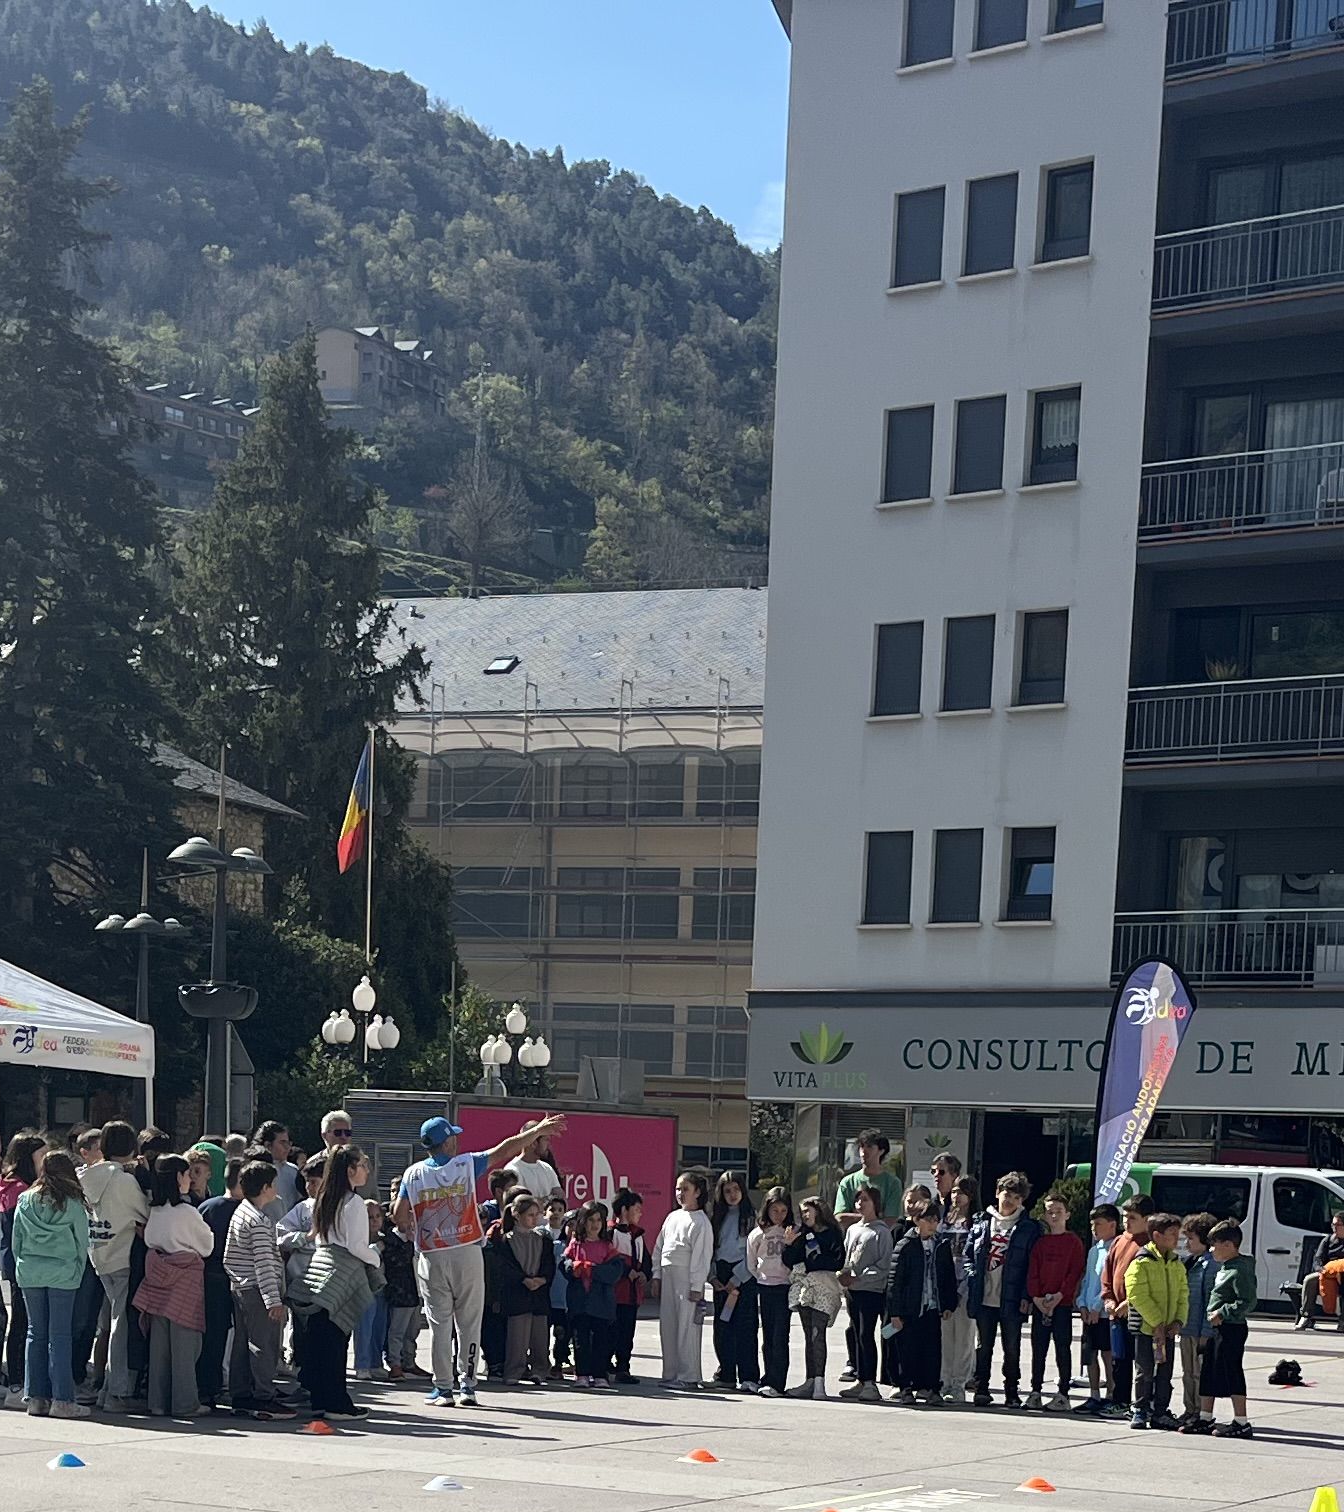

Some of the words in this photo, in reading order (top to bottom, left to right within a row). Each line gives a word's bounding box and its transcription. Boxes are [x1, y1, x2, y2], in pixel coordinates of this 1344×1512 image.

[903, 1038, 1107, 1072] CONSULTO
[1195, 1041, 1255, 1075] DE
[773, 1071, 818, 1089] VITA
[821, 1072, 868, 1089] PLUS
[1099, 1117, 1138, 1197] FEDERACIÓ
